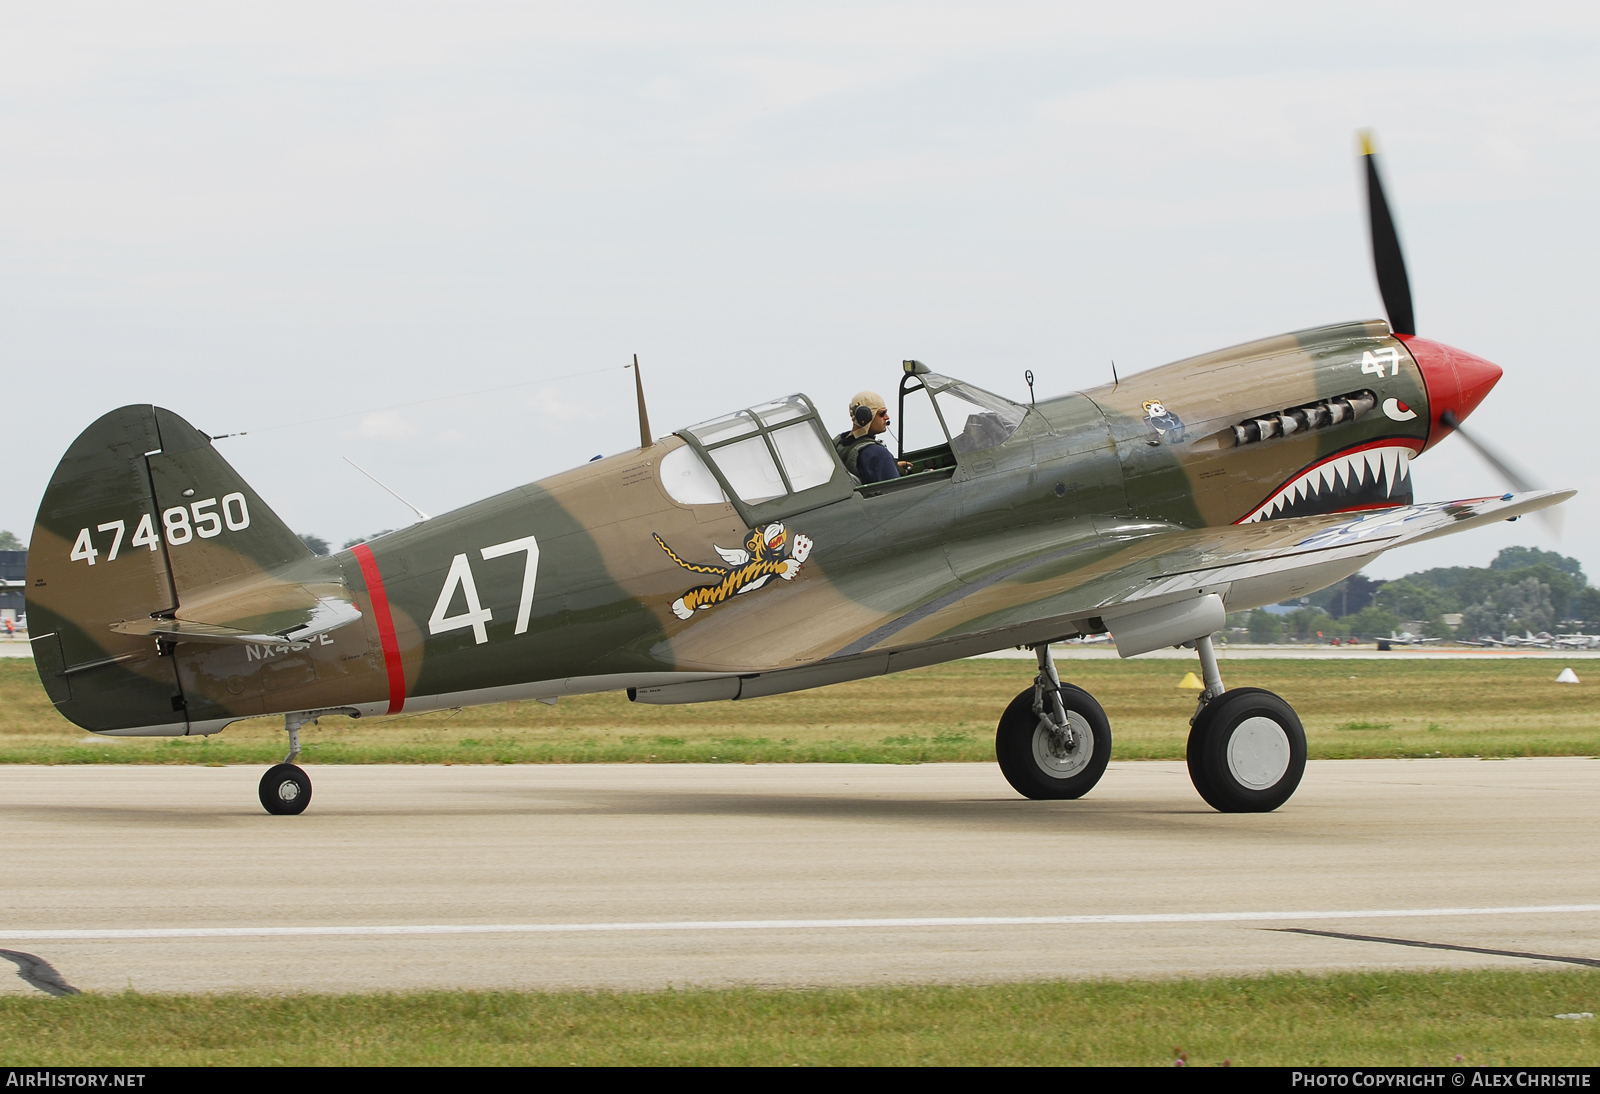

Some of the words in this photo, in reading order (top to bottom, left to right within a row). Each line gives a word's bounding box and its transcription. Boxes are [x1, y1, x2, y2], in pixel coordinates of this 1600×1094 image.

[1361, 346, 1400, 379] 47
[69, 491, 251, 566] 474850
[429, 536, 540, 645] 47
